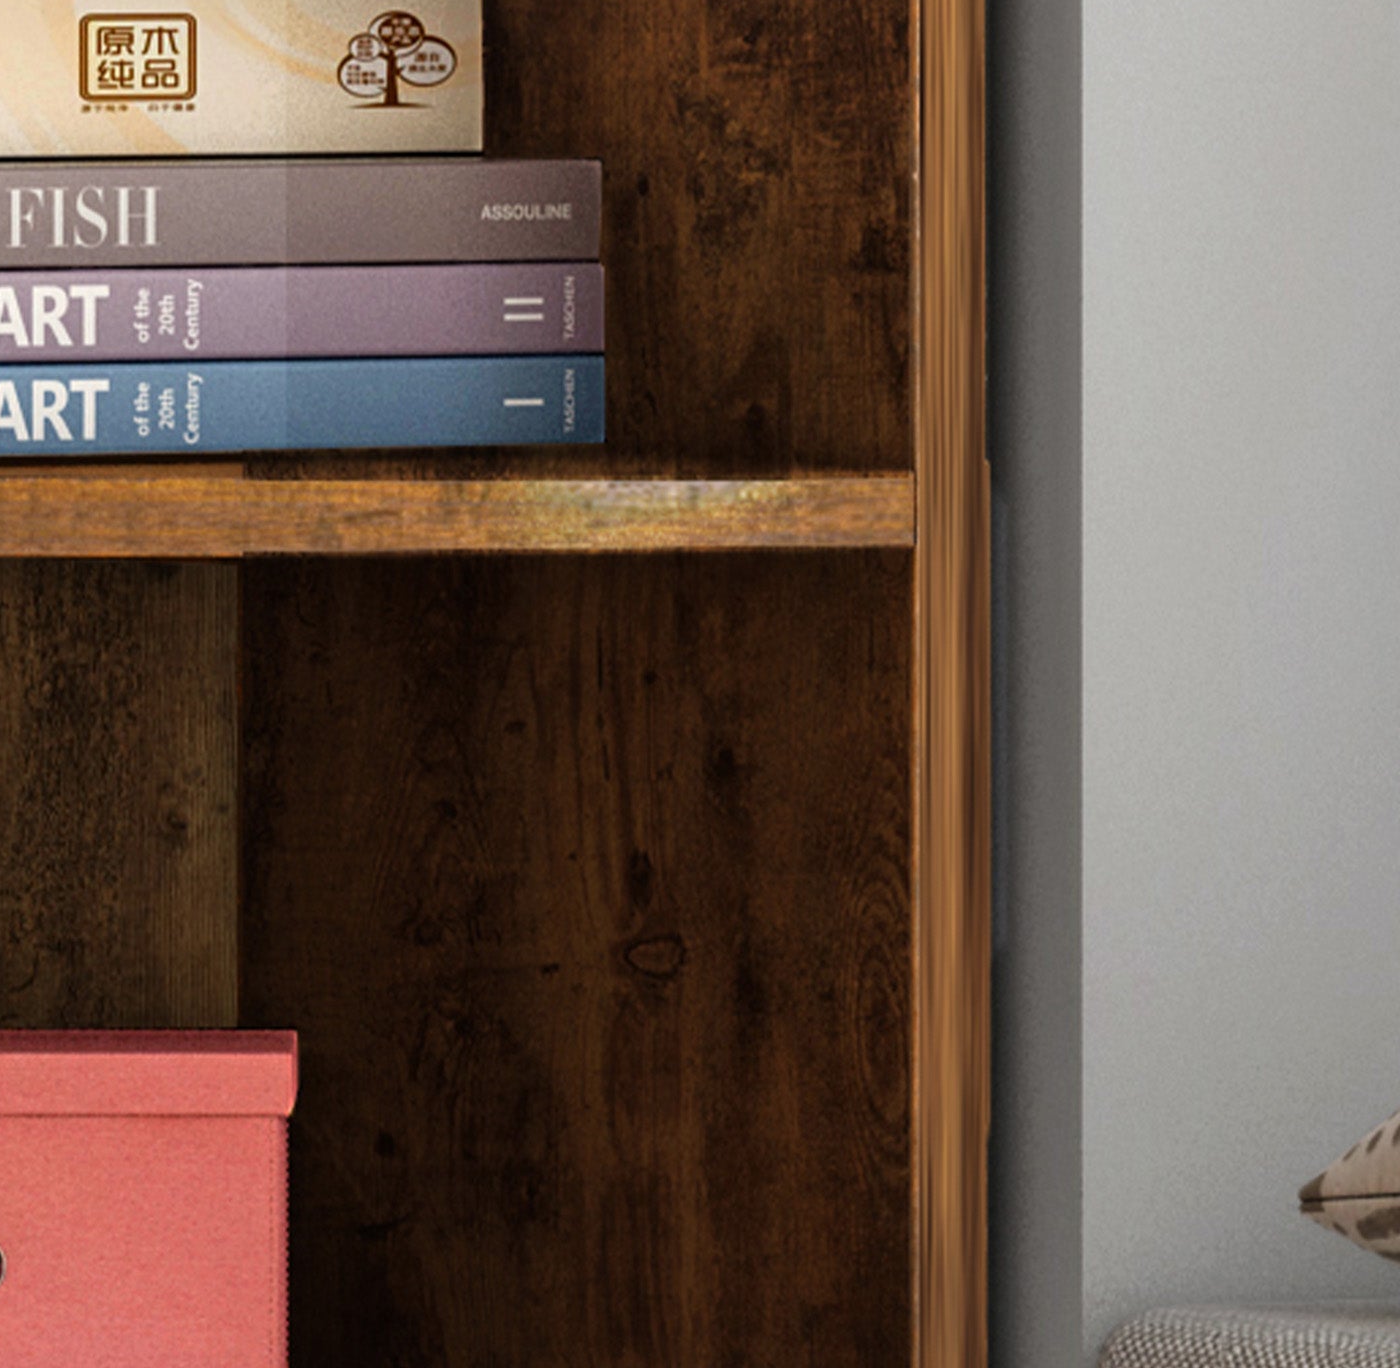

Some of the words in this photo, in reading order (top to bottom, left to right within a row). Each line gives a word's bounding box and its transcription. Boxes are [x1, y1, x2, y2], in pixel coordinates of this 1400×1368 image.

[5, 186, 162, 248] FISH
[481, 203, 573, 220] ASSOULINE
[133, 288, 150, 318] the
[158, 294, 175, 335] 20th
[183, 278, 203, 350] Century
[563, 275, 575, 341] TASCHEN
[133, 322, 150, 343] of
[133, 382, 150, 412] the
[158, 387, 175, 429] 20th
[183, 372, 203, 444] Century
[563, 368, 575, 433] TASCHEN
[133, 416, 150, 437] of
